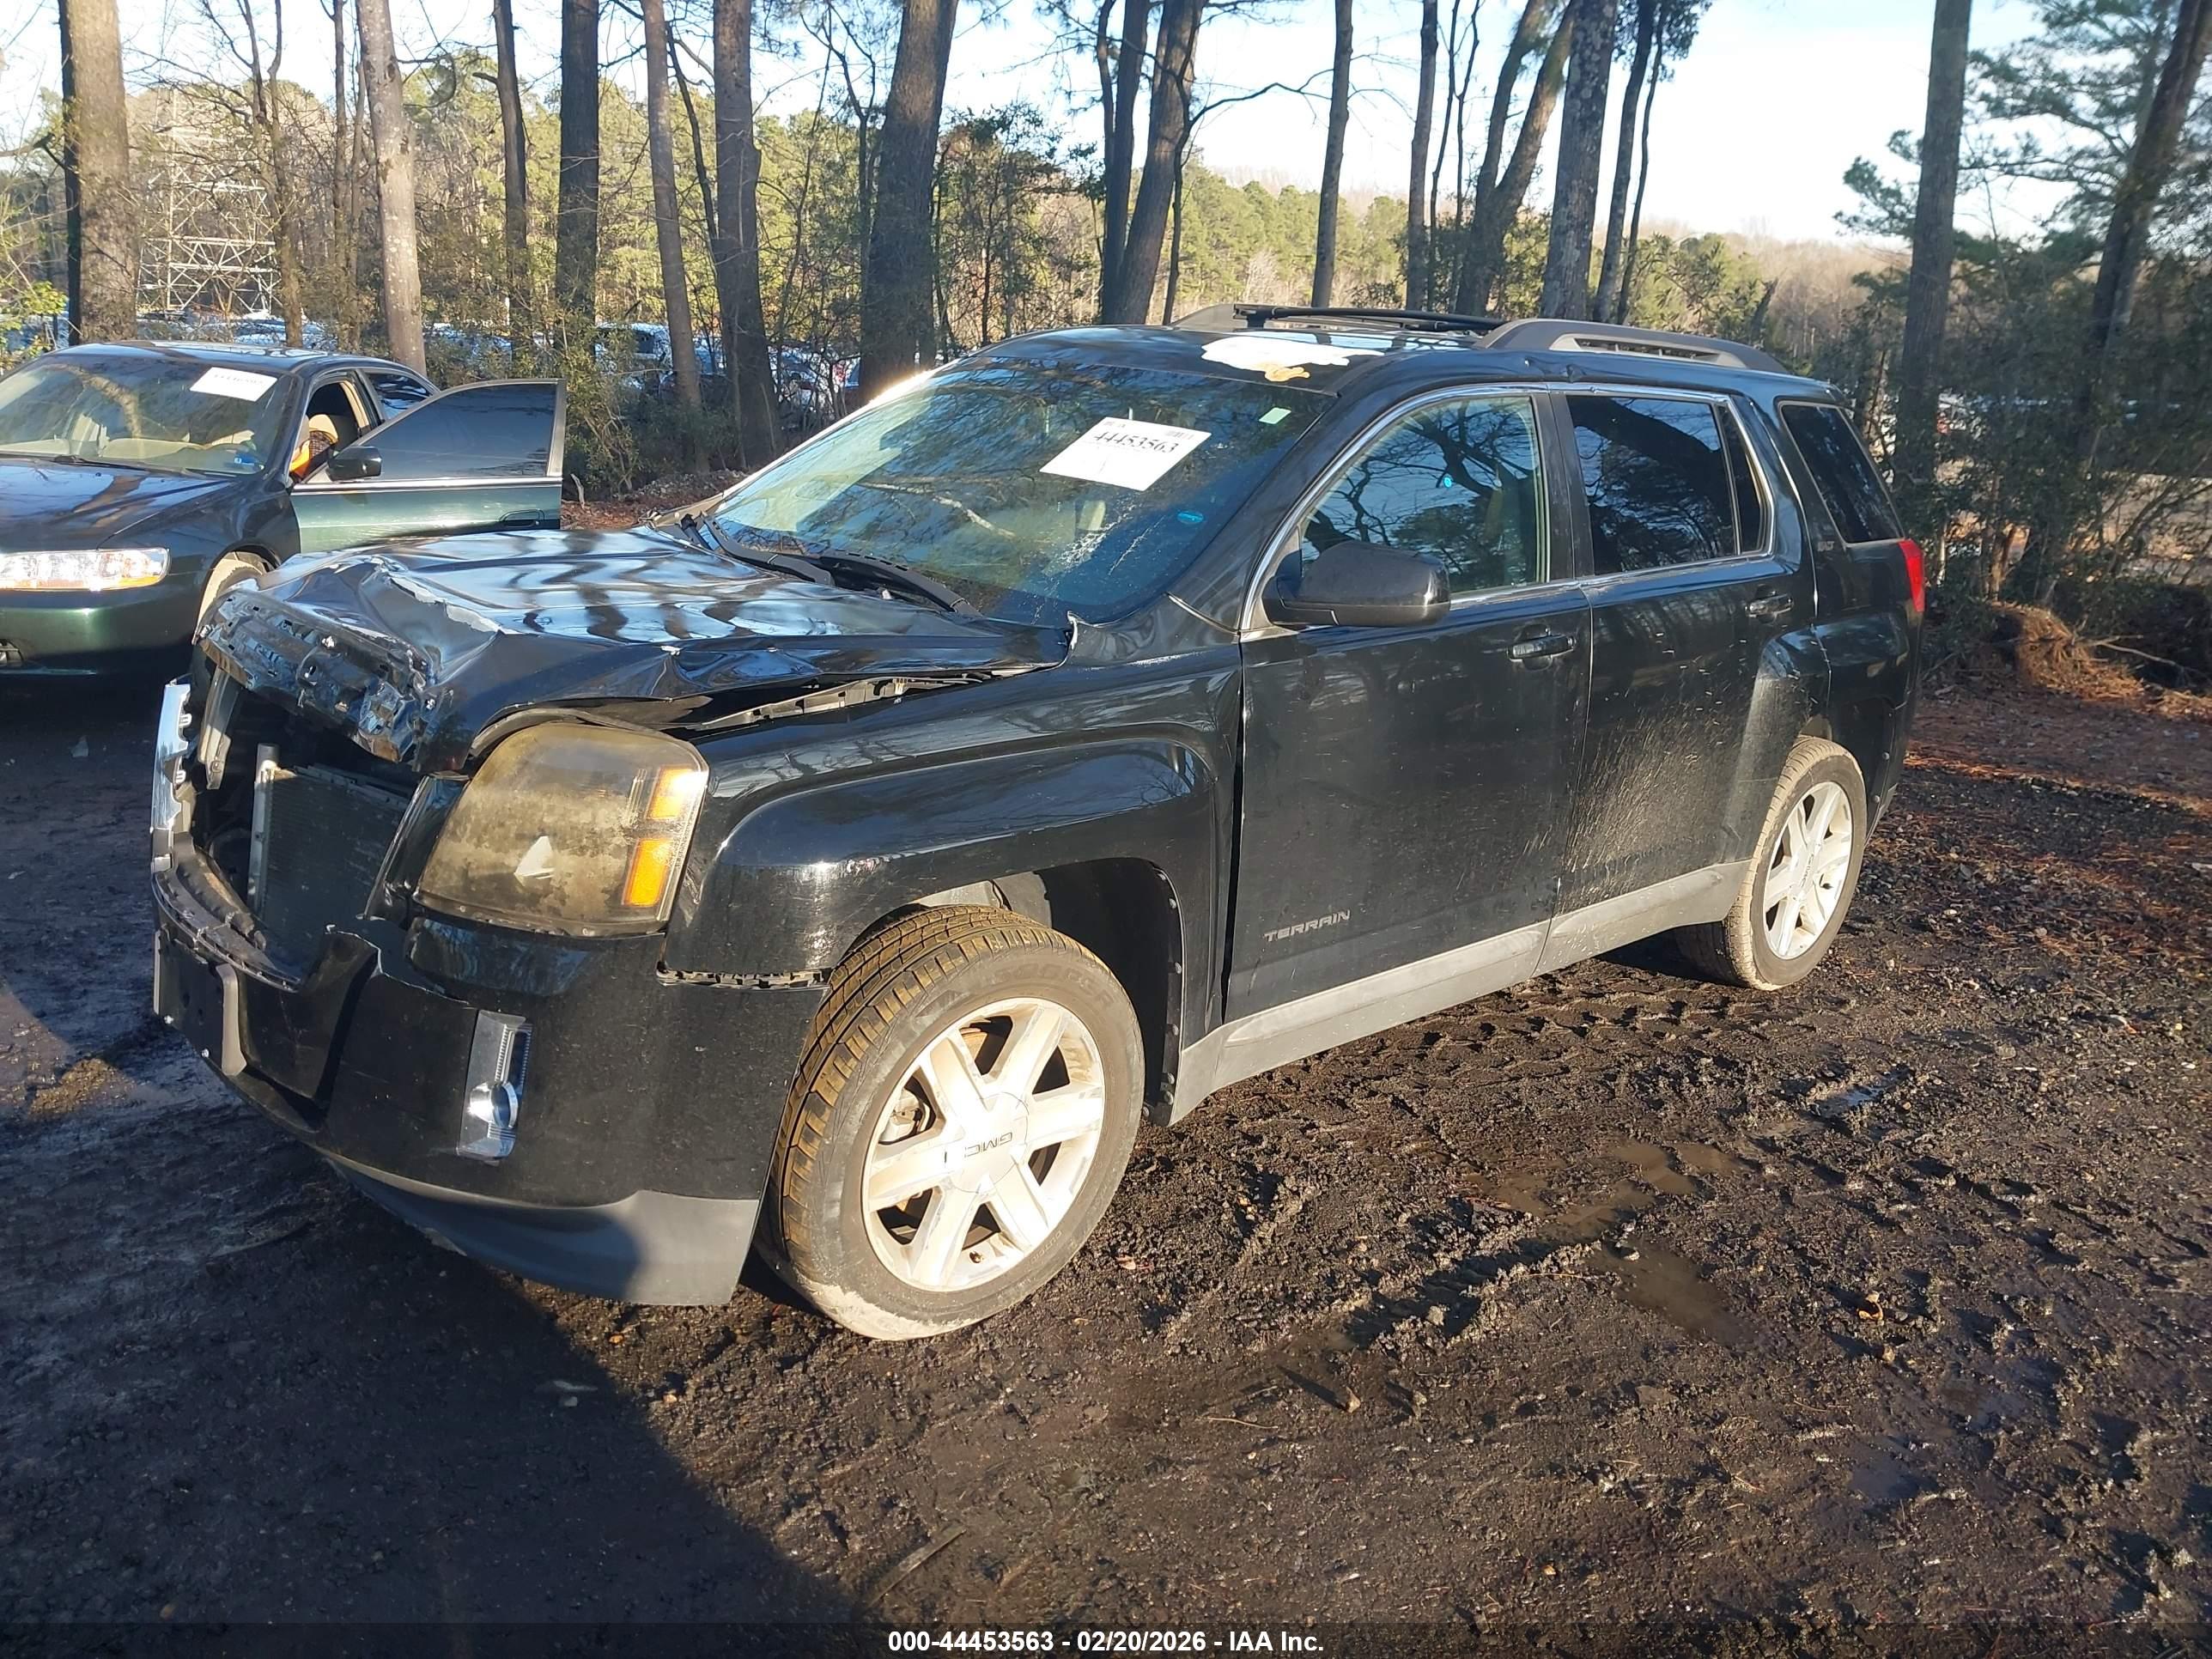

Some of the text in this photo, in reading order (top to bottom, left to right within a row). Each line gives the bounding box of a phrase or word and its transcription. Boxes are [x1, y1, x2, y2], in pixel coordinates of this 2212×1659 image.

[1094, 430, 1180, 454] 44453563
[1263, 908, 1352, 943] TERRAIN
[963, 1131, 1013, 1158] GMC
